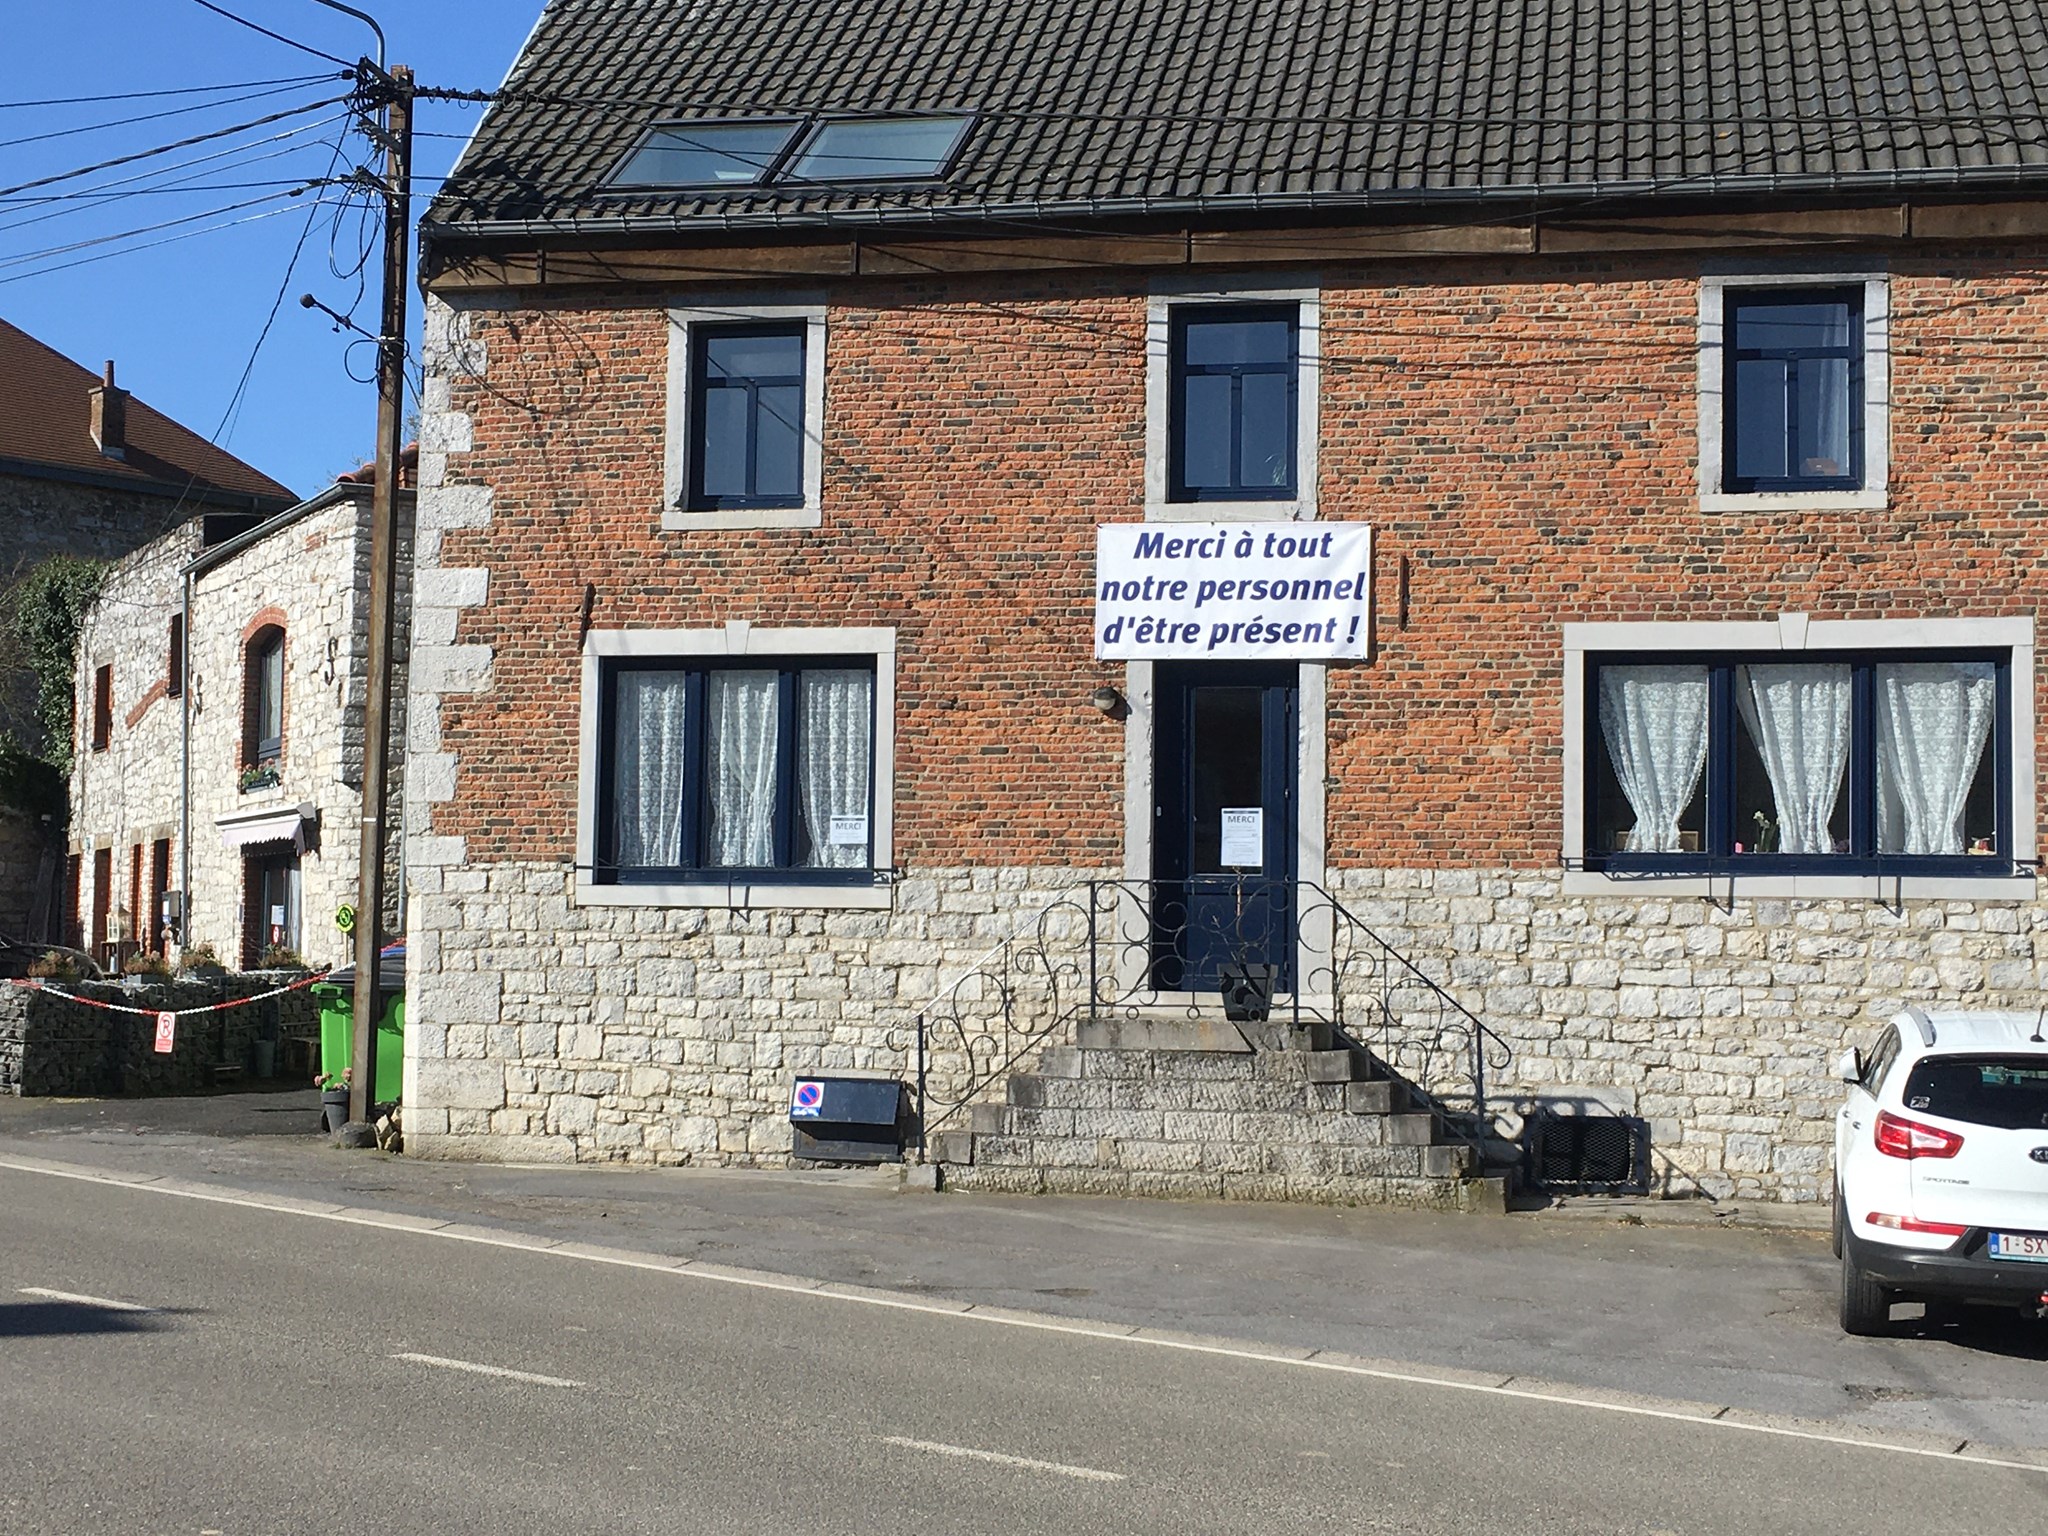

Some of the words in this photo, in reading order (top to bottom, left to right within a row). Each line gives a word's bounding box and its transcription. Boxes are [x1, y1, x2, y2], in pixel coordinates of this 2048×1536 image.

[1133, 529, 1227, 559] Merci
[1234, 530, 1254, 559] à
[1263, 532, 1334, 559] tout
[1100, 575, 1188, 602] notre
[1194, 571, 1366, 609] personnel
[1103, 615, 1201, 644] d'être
[1207, 614, 1338, 651] présent
[835, 822, 862, 830] MERCI
[1227, 815, 1255, 823] MERCI
